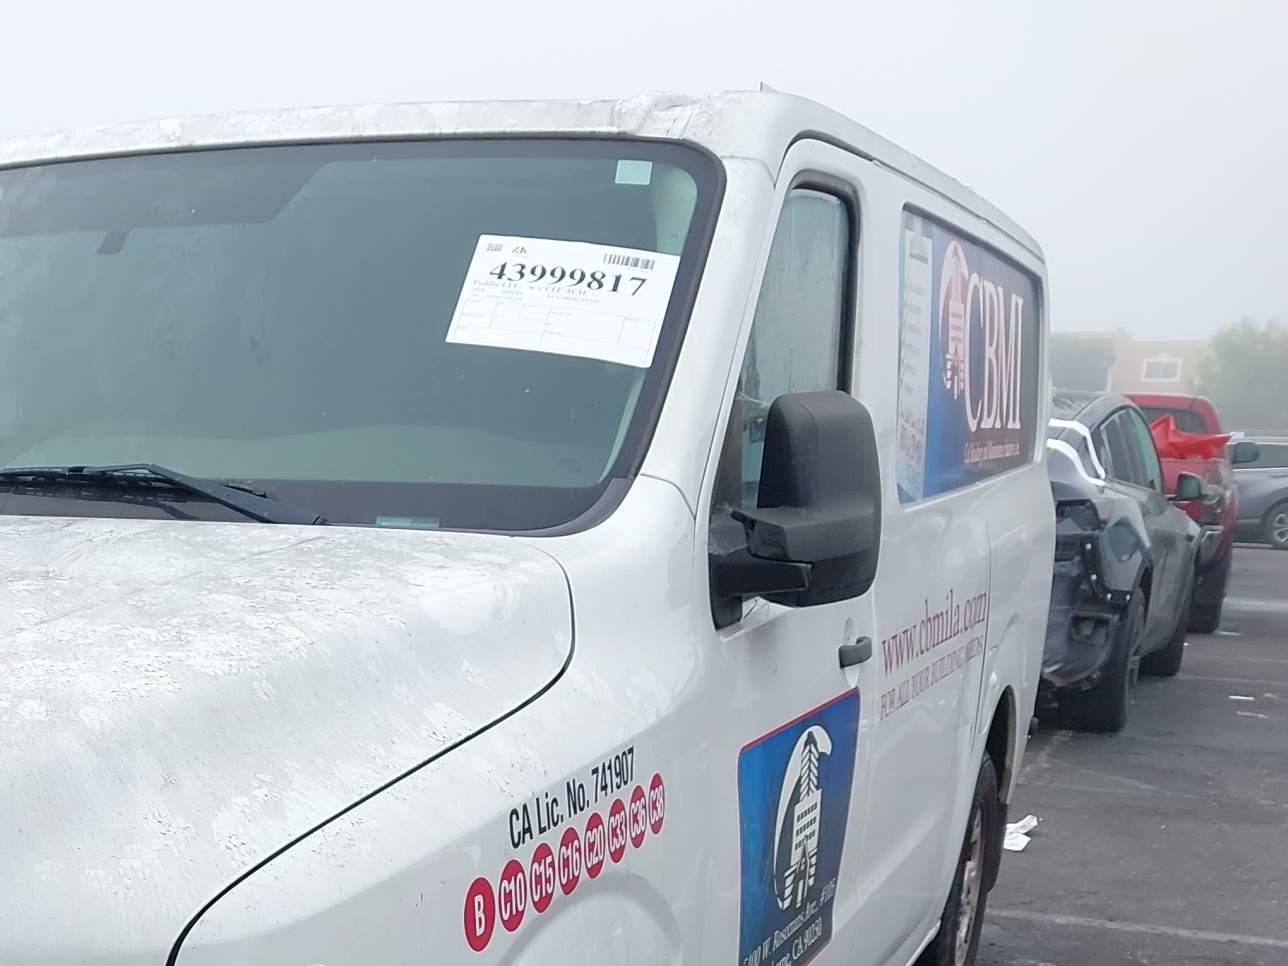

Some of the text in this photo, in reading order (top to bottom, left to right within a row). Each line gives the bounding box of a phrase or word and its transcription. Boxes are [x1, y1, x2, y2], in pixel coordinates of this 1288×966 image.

[489, 260, 647, 297] 43999817
[964, 271, 1024, 433] CBMI
[881, 588, 987, 677] www.cbmila.com
[509, 746, 634, 849] CA Lic. No. 741907
[474, 894, 486, 936] B
[500, 872, 526, 921] C10
[531, 854, 554, 902] C15
[558, 839, 580, 885] C16
[585, 825, 604, 868] C20
[608, 810, 626, 852] C33
[792, 935, 804, 960] CA
